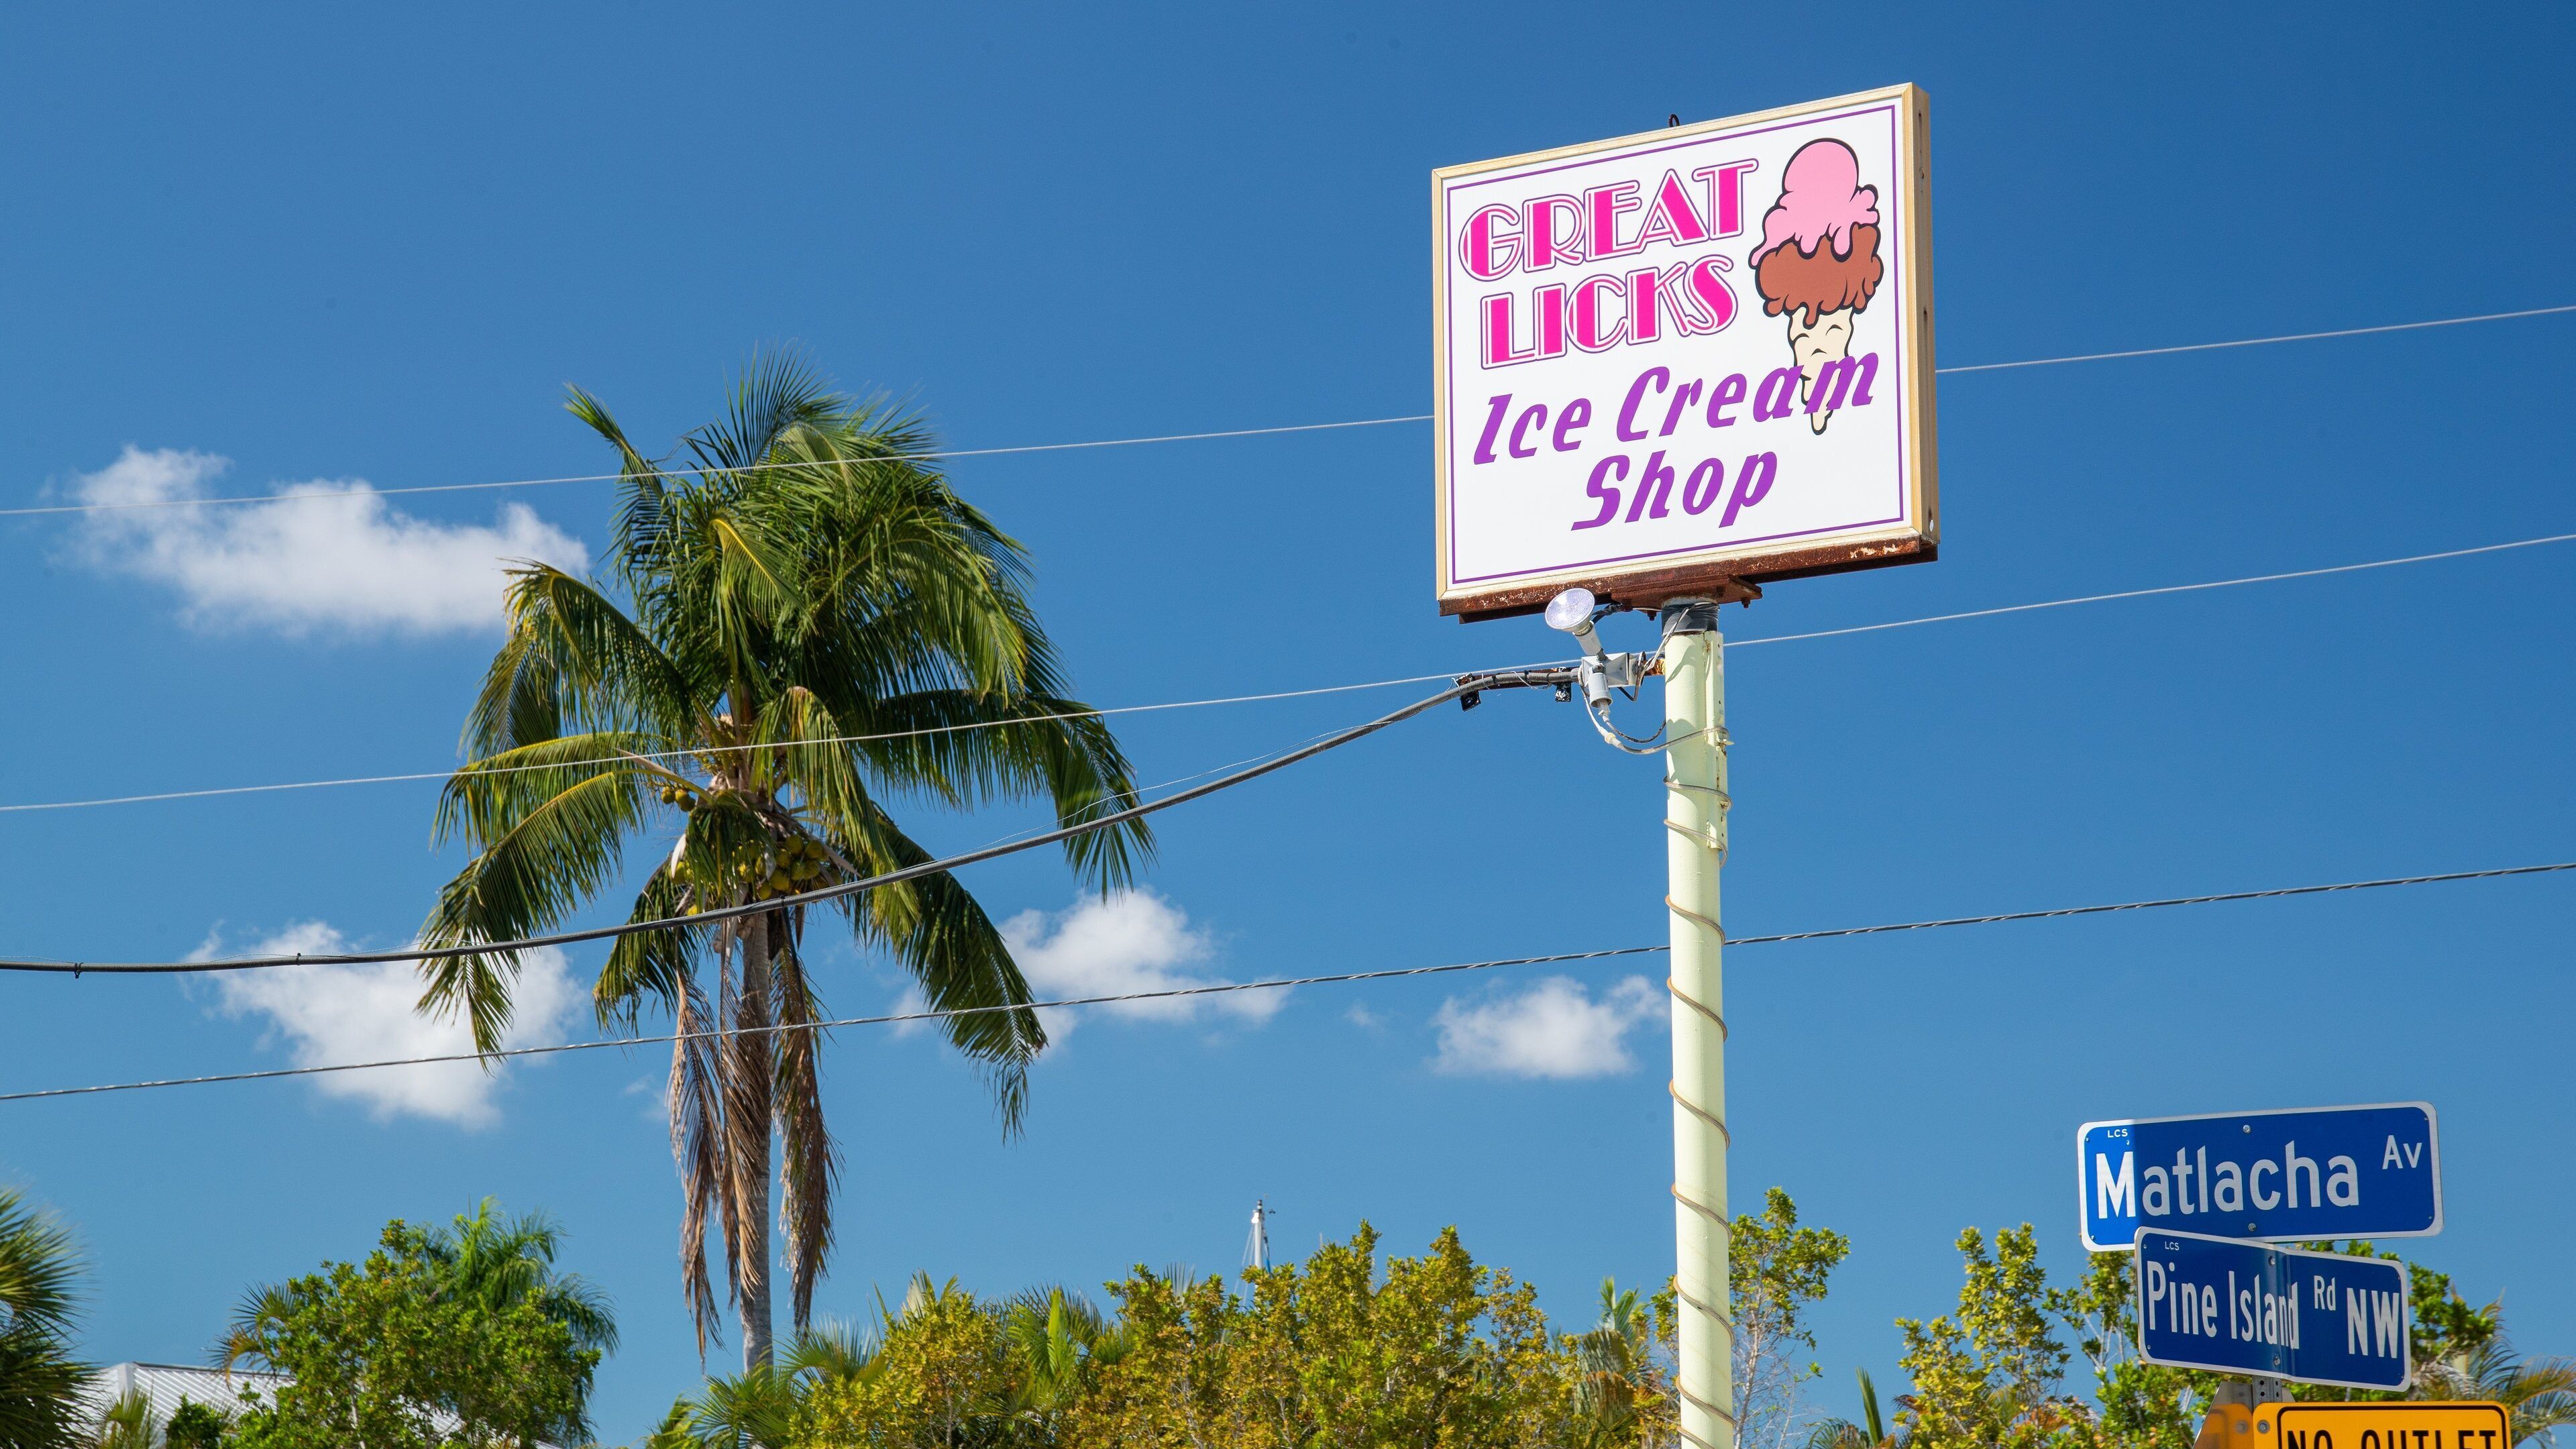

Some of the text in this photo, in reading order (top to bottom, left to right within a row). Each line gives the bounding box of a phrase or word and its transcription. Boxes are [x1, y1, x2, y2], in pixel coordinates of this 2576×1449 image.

[1458, 158, 1759, 282] GREAT
[1481, 254, 1738, 370] LICKS
[1474, 352, 1879, 465] Ice Cream
[1570, 449, 1778, 531] Shop
[2096, 1135, 2422, 1218] Matlacha Av
[2107, 1128, 2129, 1138] LCS
[2164, 1240, 2180, 1251] LCS
[2147, 1260, 2400, 1358] Pine Island Rd NW
